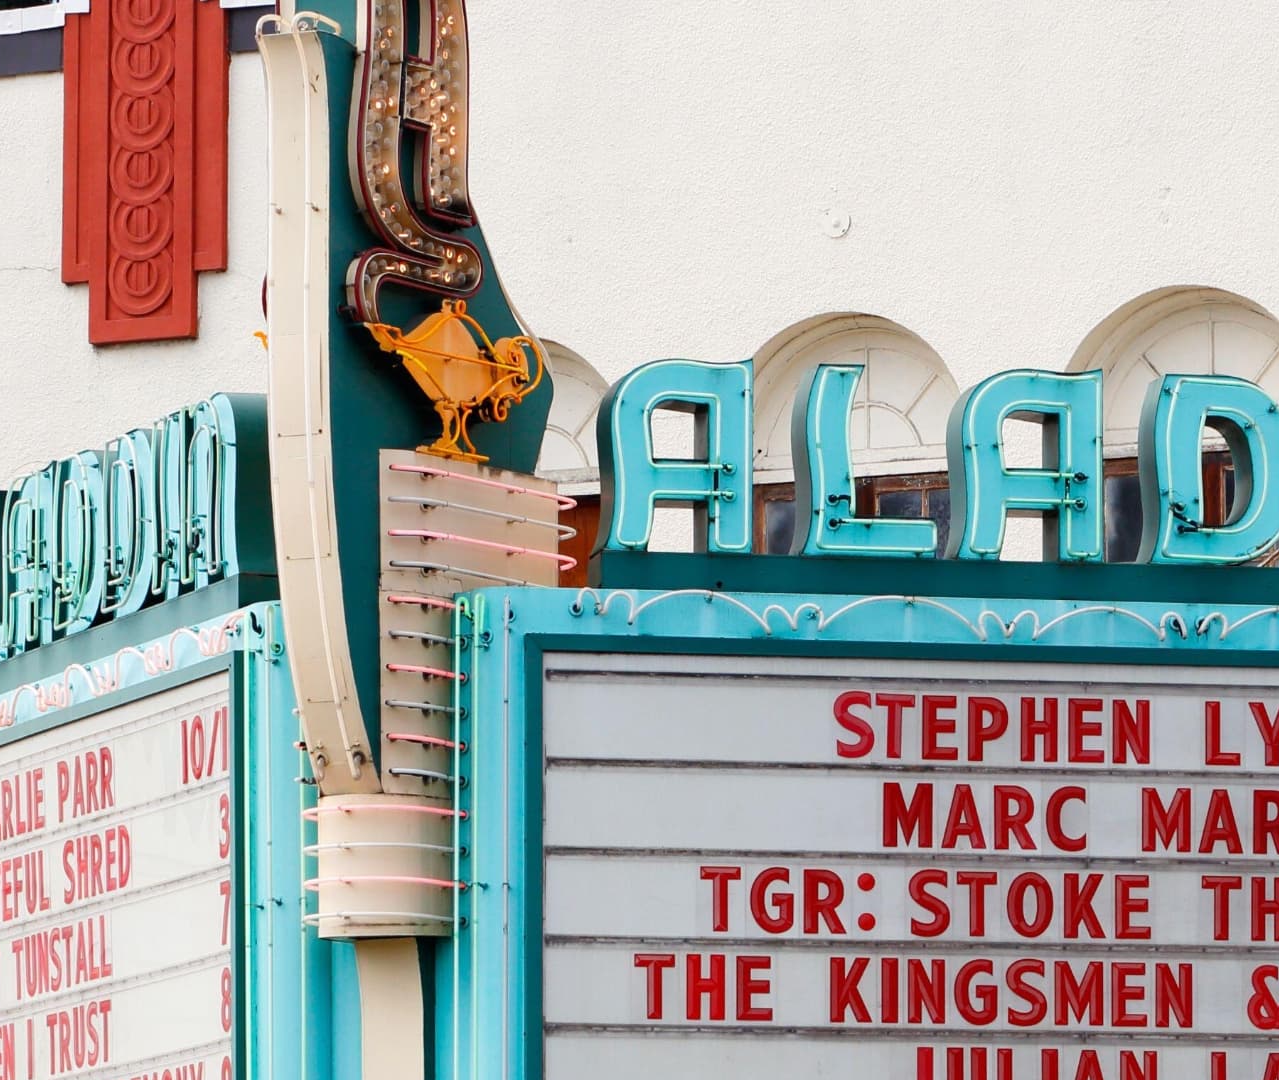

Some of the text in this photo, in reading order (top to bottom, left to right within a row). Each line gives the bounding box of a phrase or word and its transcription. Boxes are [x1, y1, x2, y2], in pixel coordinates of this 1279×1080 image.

[56, 746, 115, 821] PARR
[180, 706, 228, 785] 10/1
[834, 690, 1151, 765] STEPHEN
[62, 824, 132, 905] SHRED
[218, 793, 230, 860] 3
[882, 781, 1087, 853] MARC
[10, 914, 113, 1000] TUNSTALL
[219, 879, 231, 946] 7
[700, 865, 876, 936] TGR:
[910, 870, 1152, 941] STOKE
[46, 998, 112, 1074] TRUST
[221, 967, 232, 1033] 8
[634, 953, 773, 1022] THE
[829, 956, 1194, 1029] KINGSMEN
